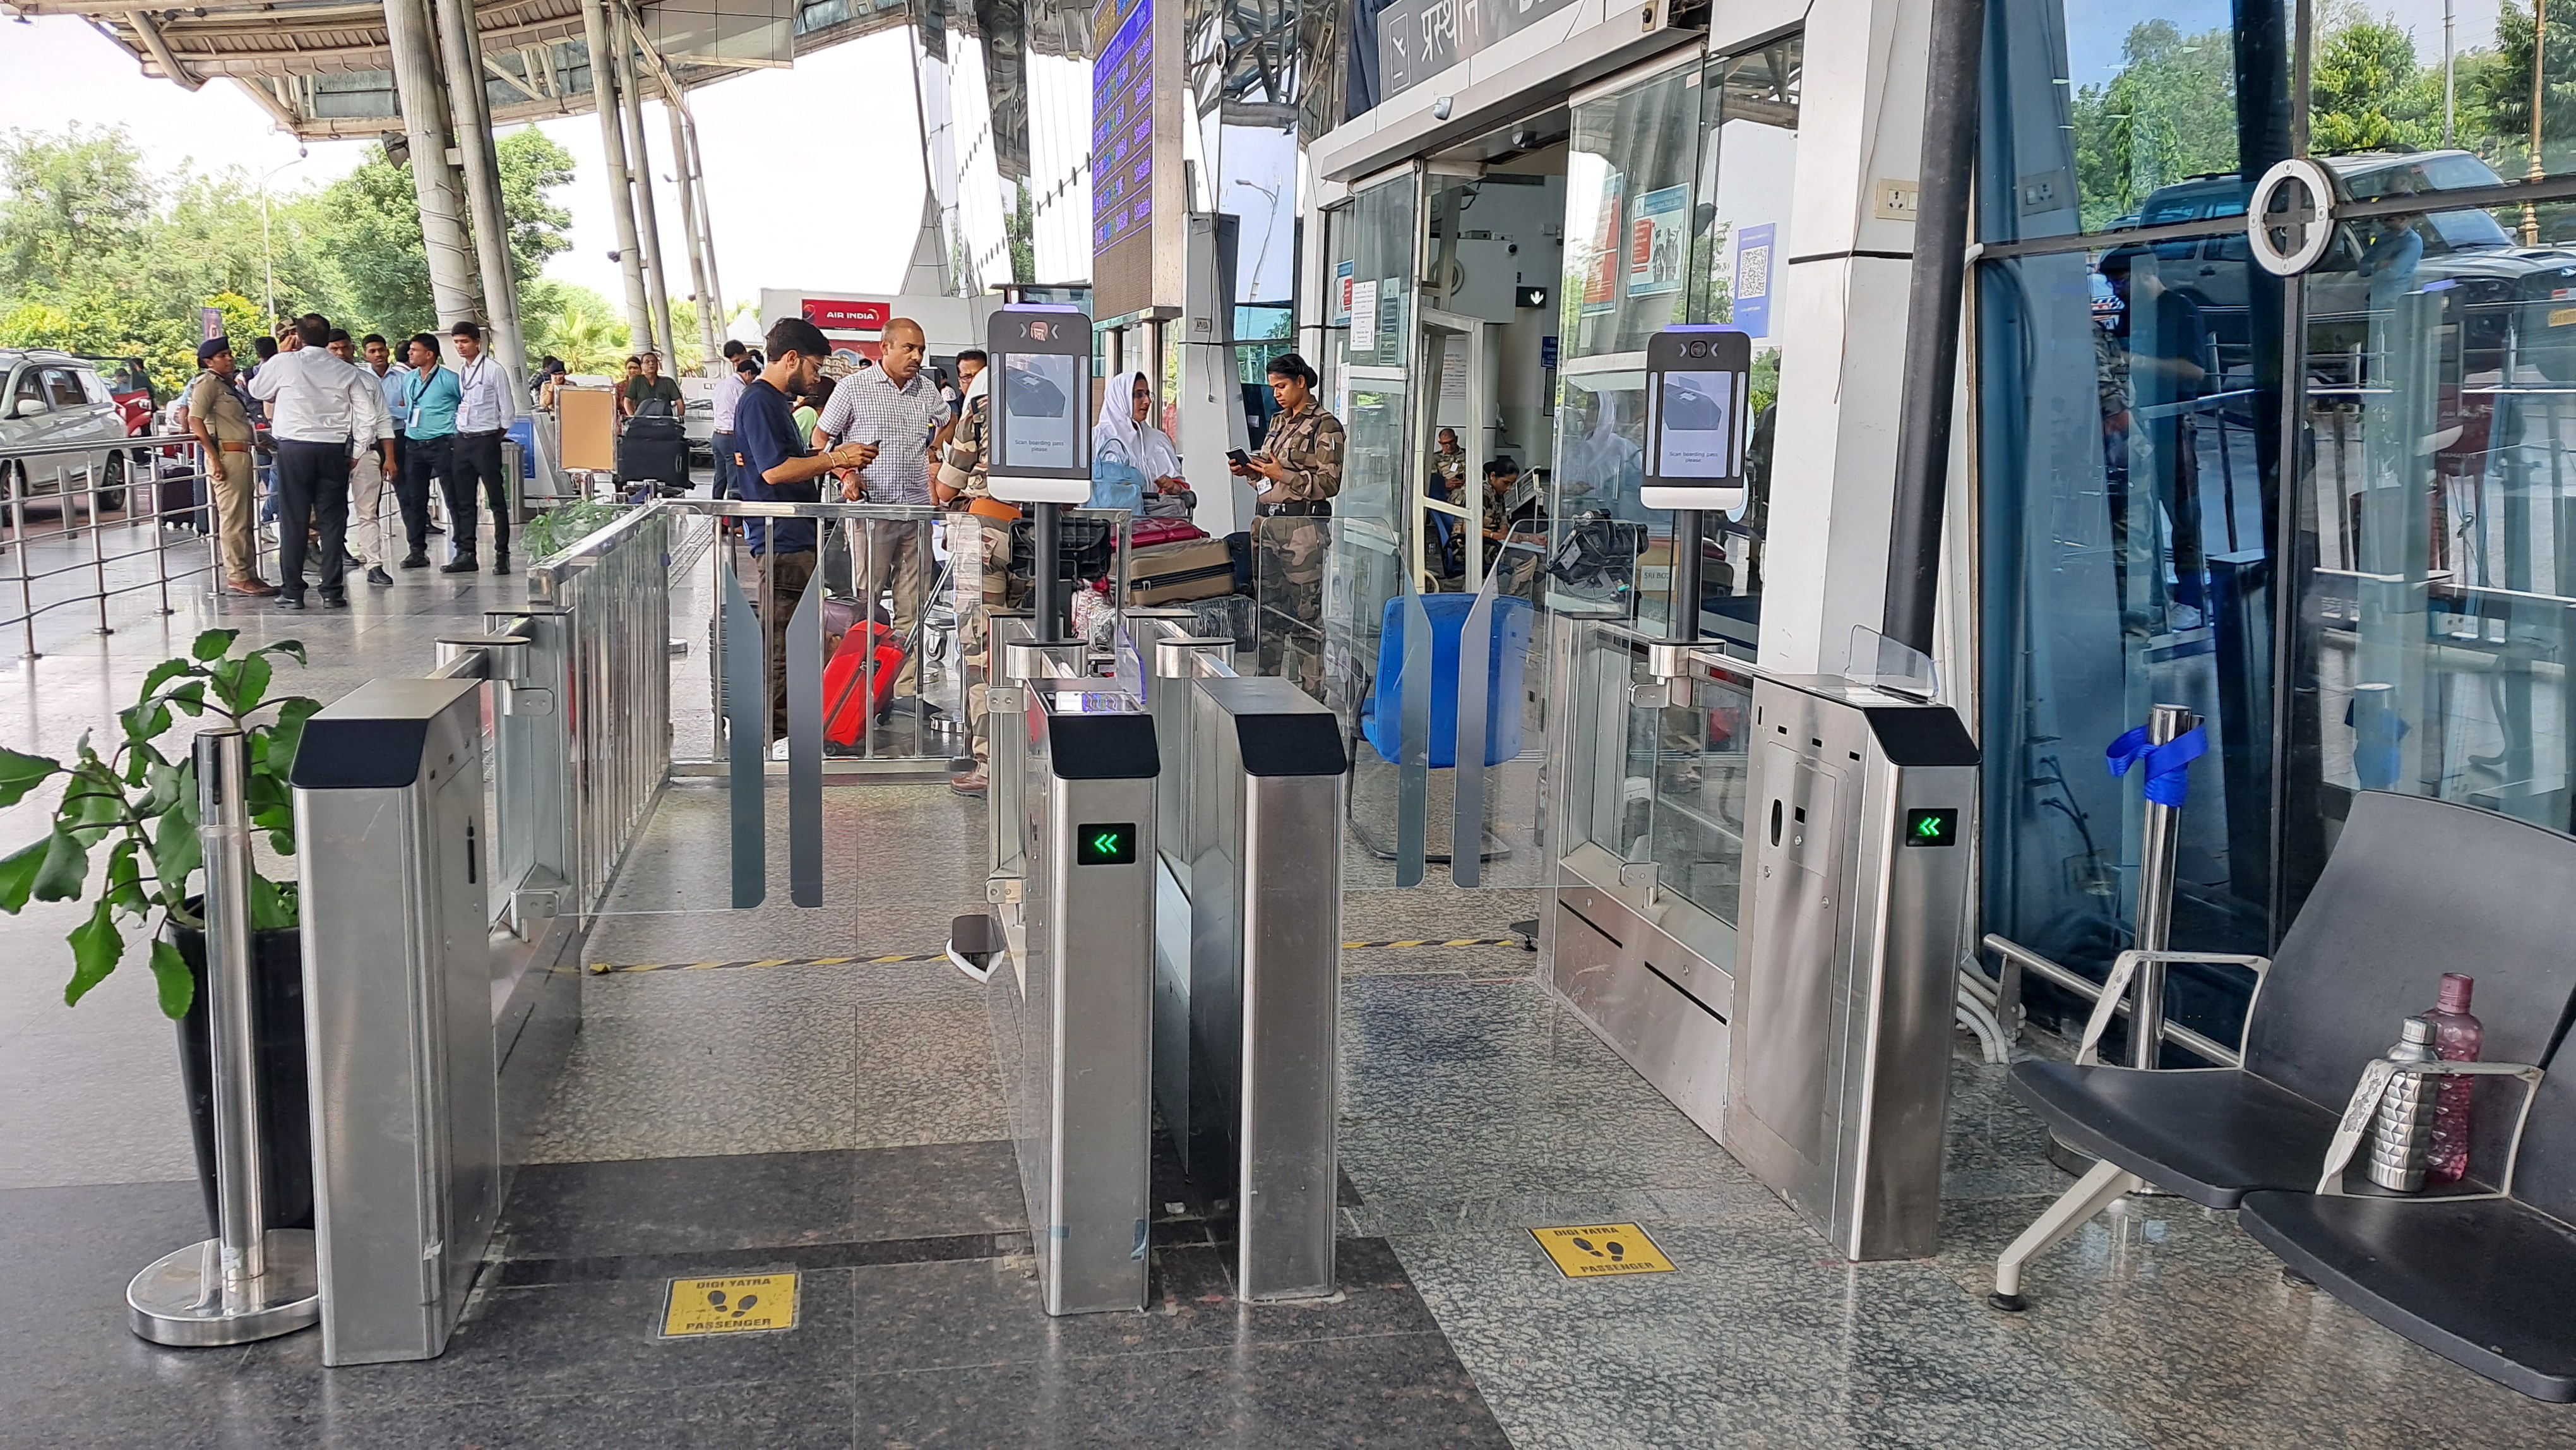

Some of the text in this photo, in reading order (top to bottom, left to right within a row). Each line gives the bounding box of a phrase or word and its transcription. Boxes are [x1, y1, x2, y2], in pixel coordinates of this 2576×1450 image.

[1580, 1262, 1655, 1273] PASSENGER
[696, 1278, 771, 1289] DIGI YATRA
[686, 1318, 771, 1329] PASSENGER
